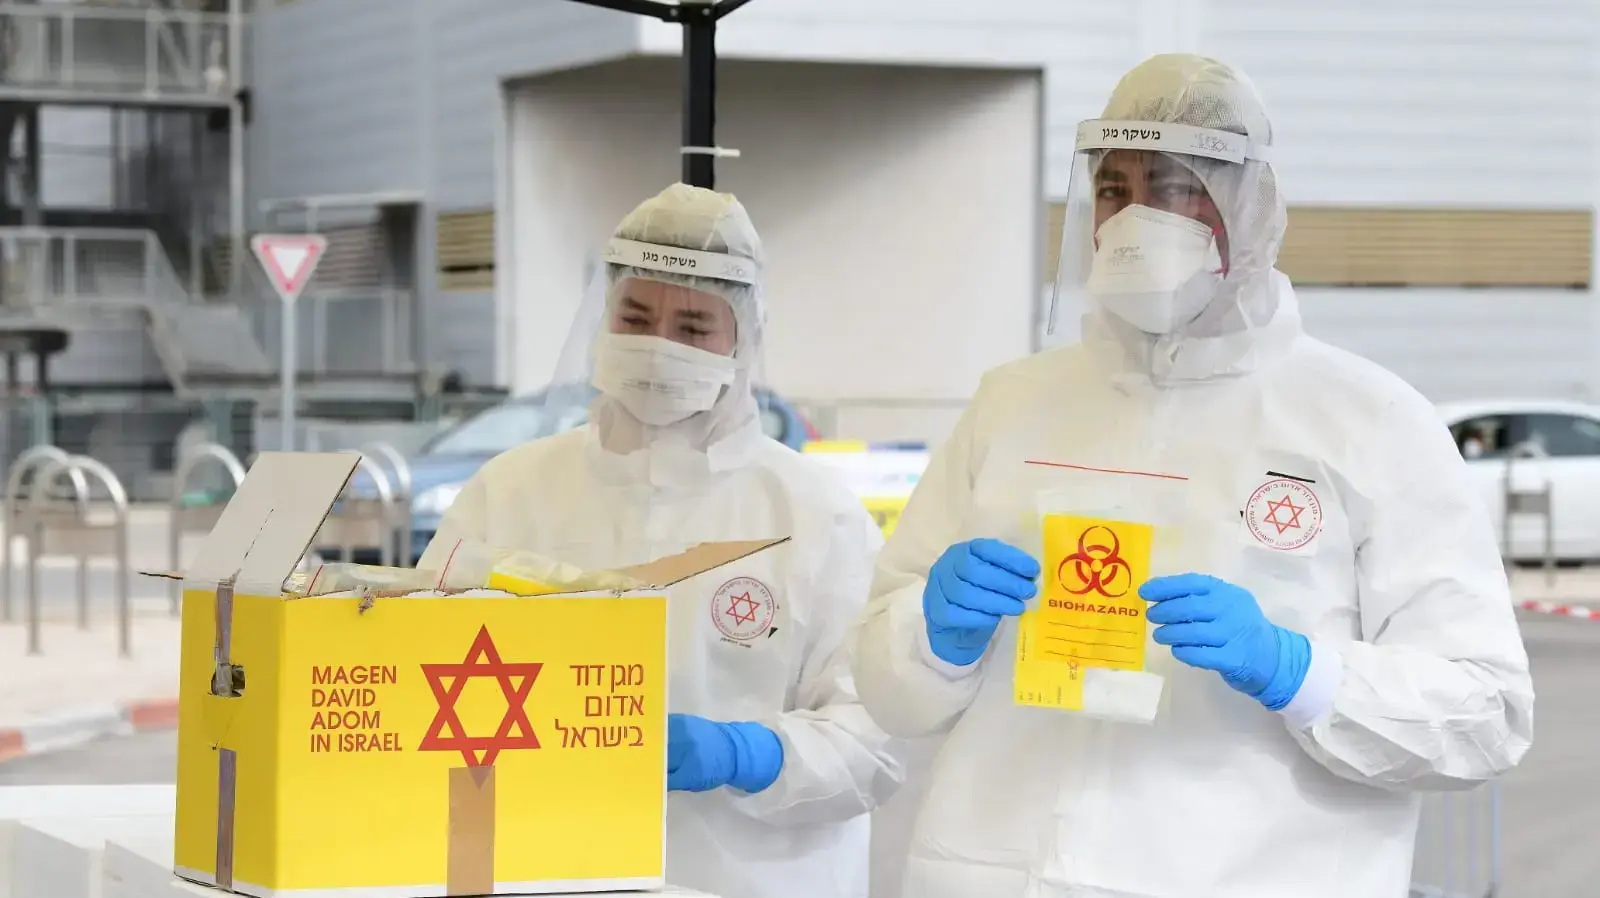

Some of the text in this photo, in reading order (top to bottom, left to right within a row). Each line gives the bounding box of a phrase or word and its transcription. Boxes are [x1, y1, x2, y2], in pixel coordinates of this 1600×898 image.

[1102, 127, 1161, 141] משקף מגן
[642, 251, 697, 268] משקף מגן
[1048, 599, 1139, 617] BIOHAZARD
[312, 665, 397, 685] MAGEN
[569, 663, 644, 693] מגן דוד
[311, 688, 376, 707] DAVID
[584, 694, 645, 718] אדום
[310, 710, 381, 730] ADOM
[310, 732, 402, 753] IN ISRAEL
[554, 718, 644, 749] בישראל
